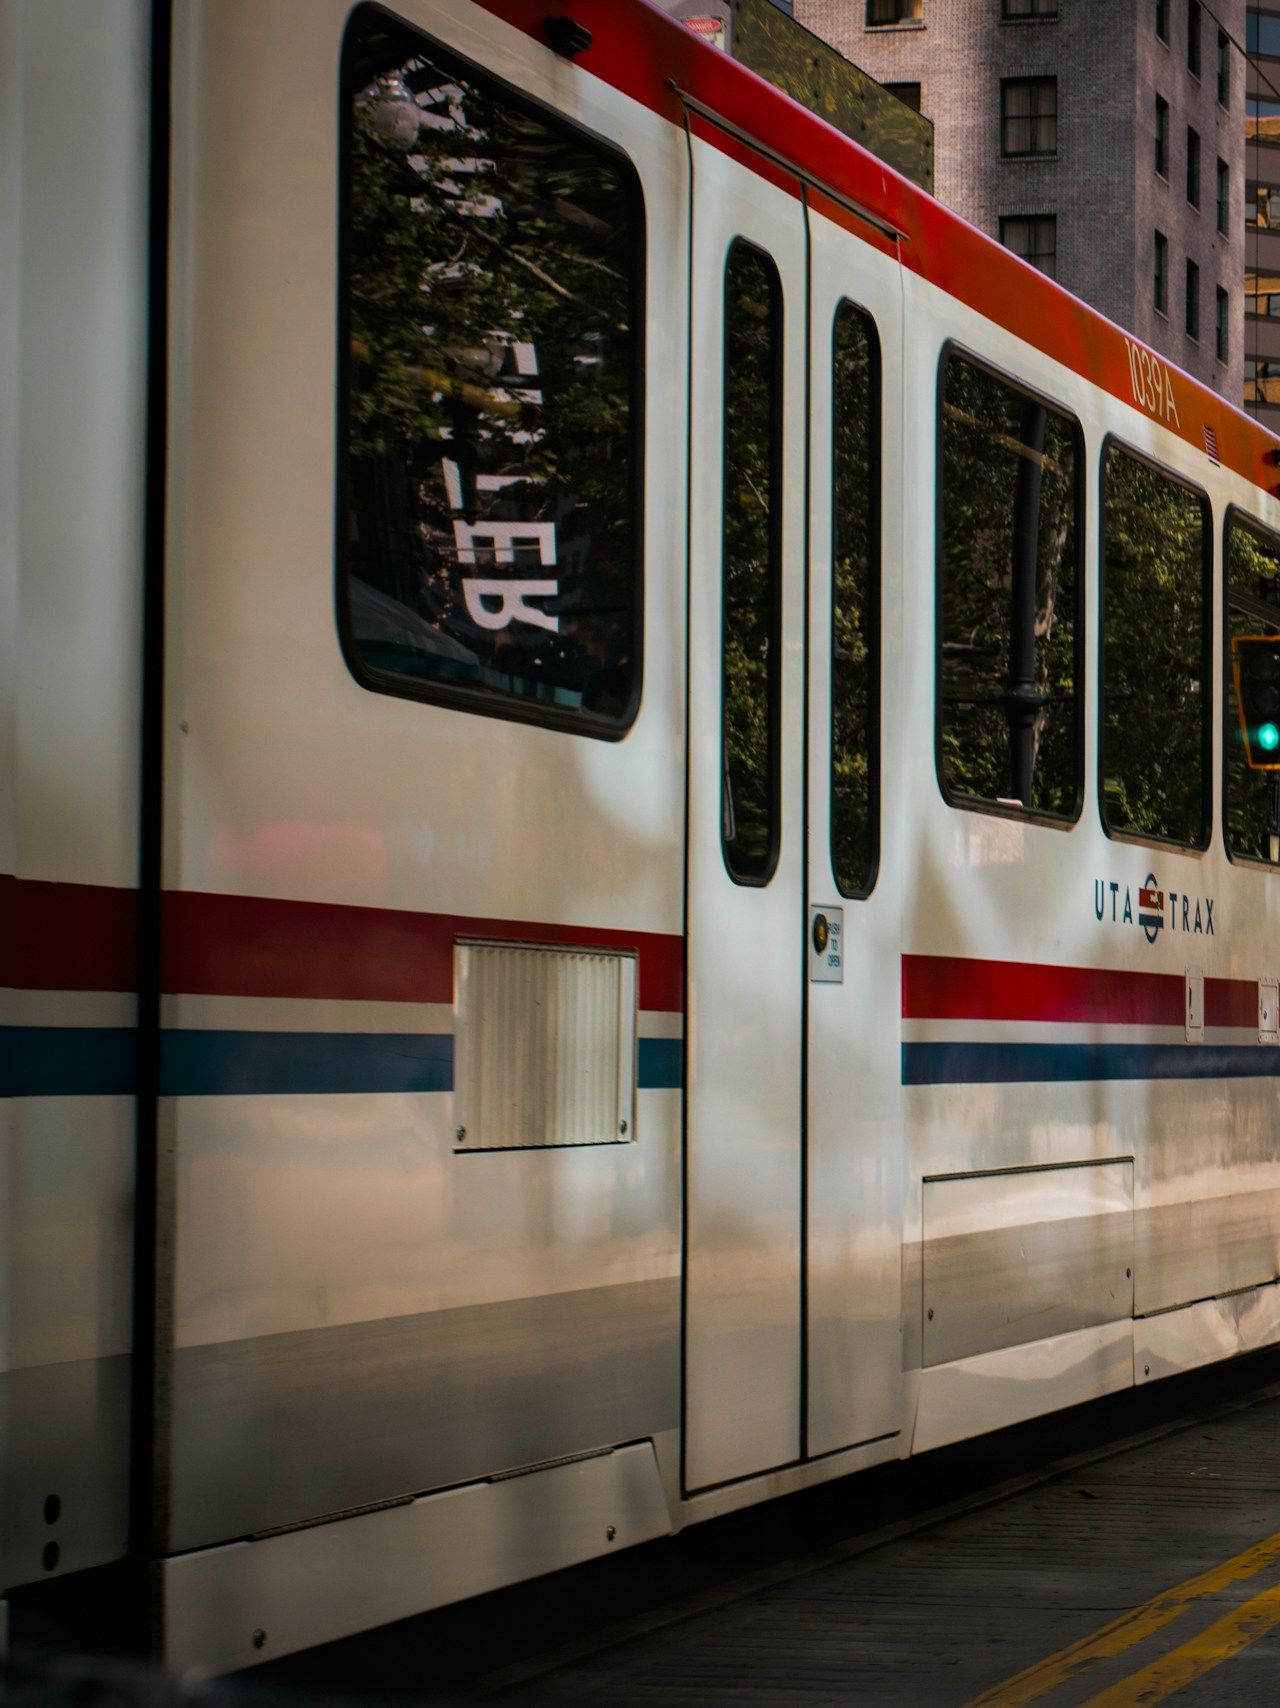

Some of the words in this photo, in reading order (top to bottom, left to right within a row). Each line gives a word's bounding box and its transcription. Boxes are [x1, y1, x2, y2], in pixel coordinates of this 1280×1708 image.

[1125, 338, 1180, 428] 1039A
[1094, 879, 1133, 924] UTA
[1169, 892, 1214, 936] TRAX
